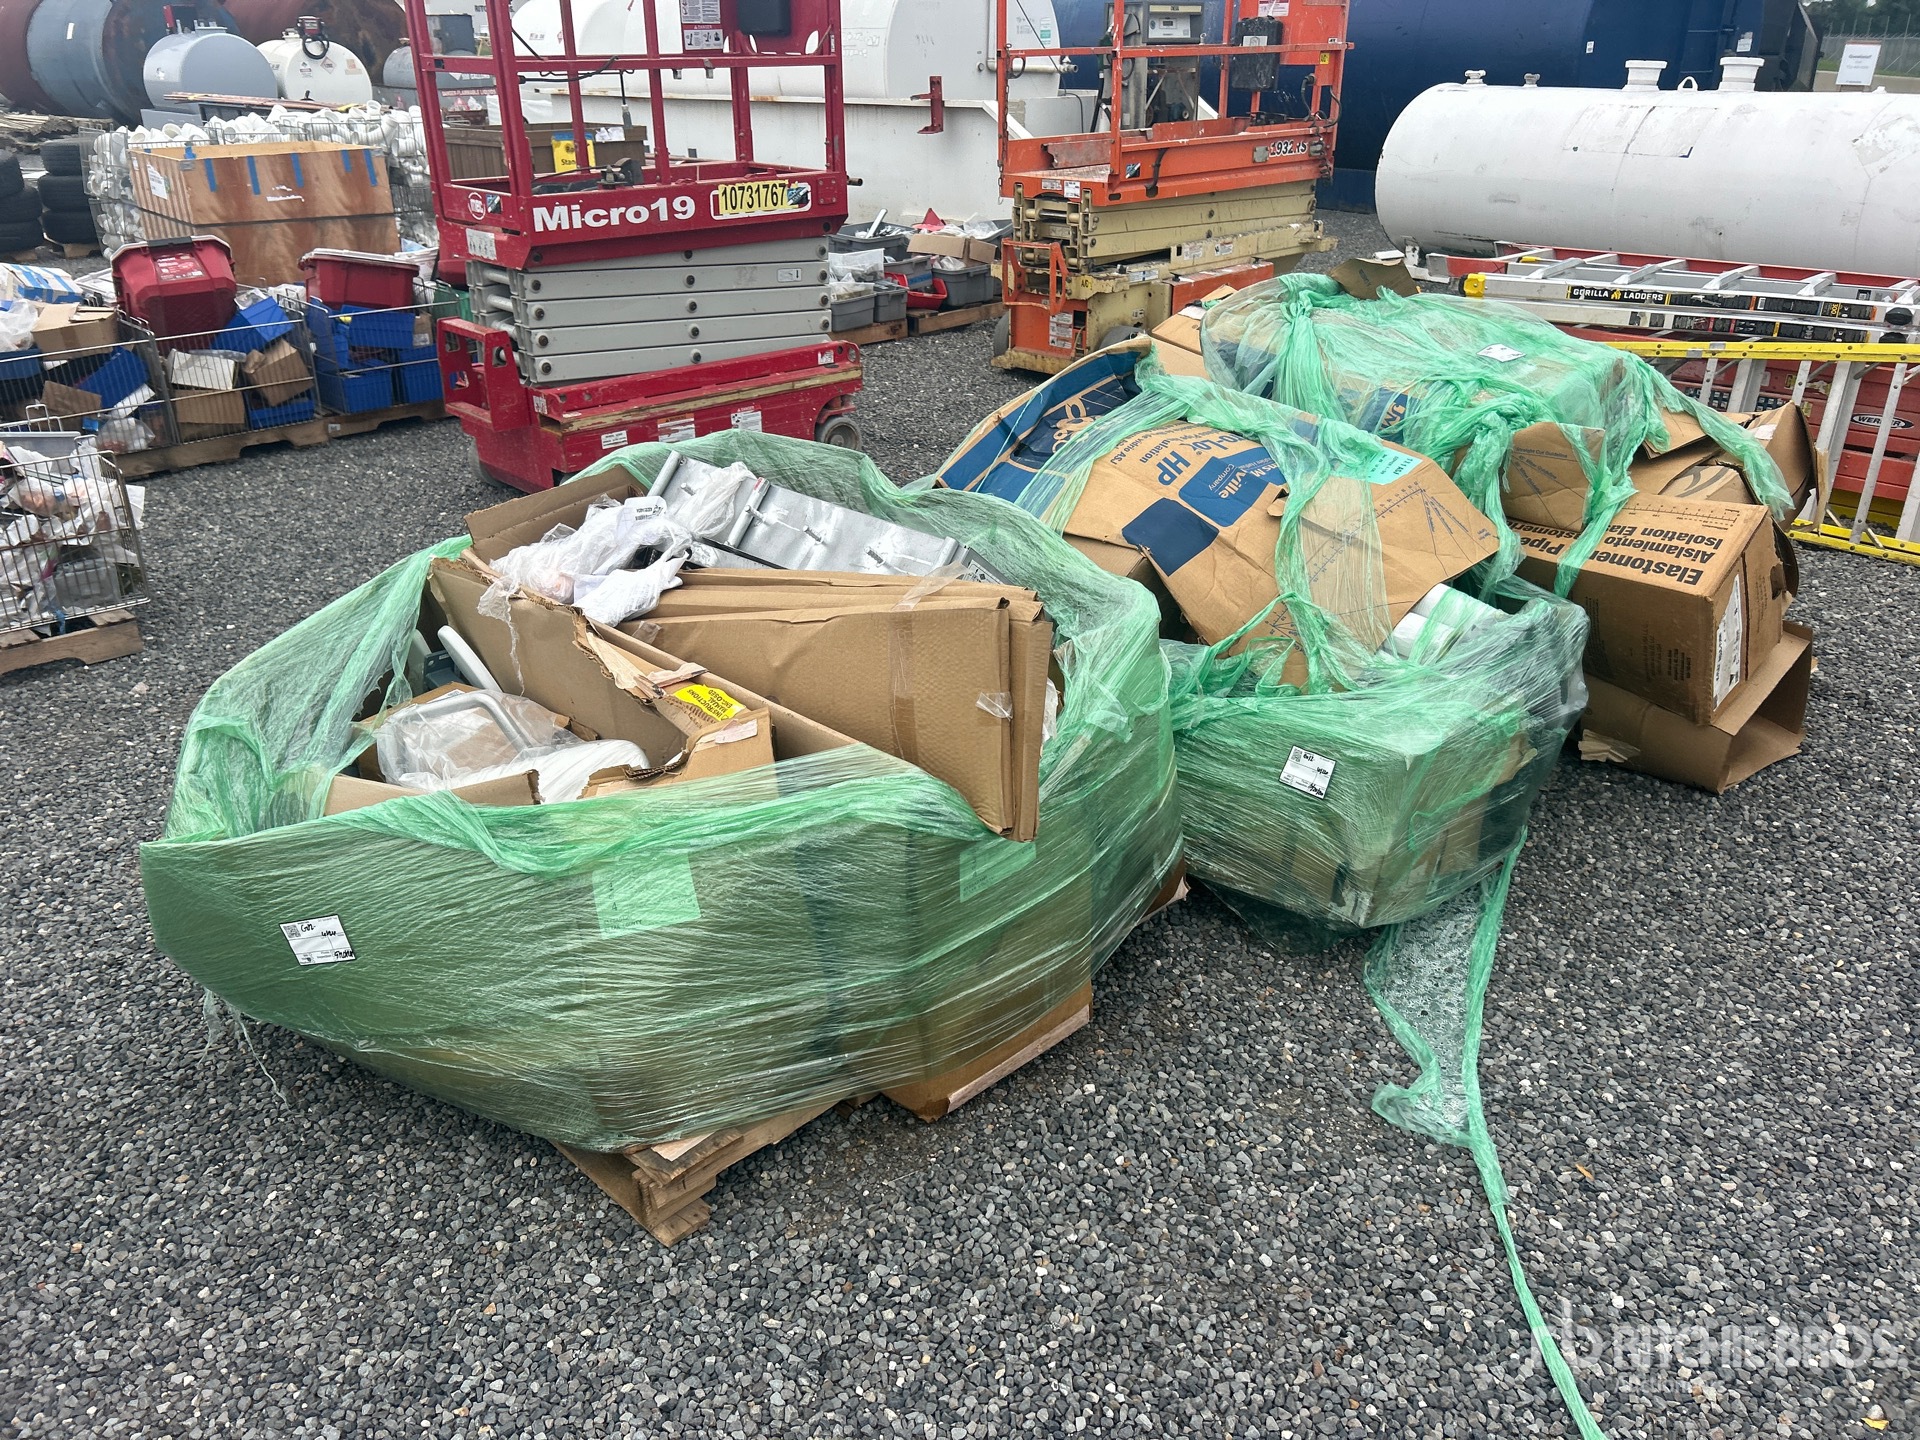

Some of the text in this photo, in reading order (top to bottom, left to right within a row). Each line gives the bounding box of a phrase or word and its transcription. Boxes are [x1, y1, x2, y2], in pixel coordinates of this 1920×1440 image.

[721, 183, 788, 211] 10731767
[532, 195, 697, 233] Micro19
[1623, 290, 1664, 301] LADDERS
[1858, 416, 1902, 427] WERR
[1156, 450, 1191, 486] HP
[1603, 535, 1716, 564] Aislamiento
[1641, 527, 1724, 550] Isolation
[1520, 537, 1704, 586] Elastomer Pipe
[686, 689, 723, 718] INSTRUCTIONS
[708, 697, 729, 713] MANUAL
